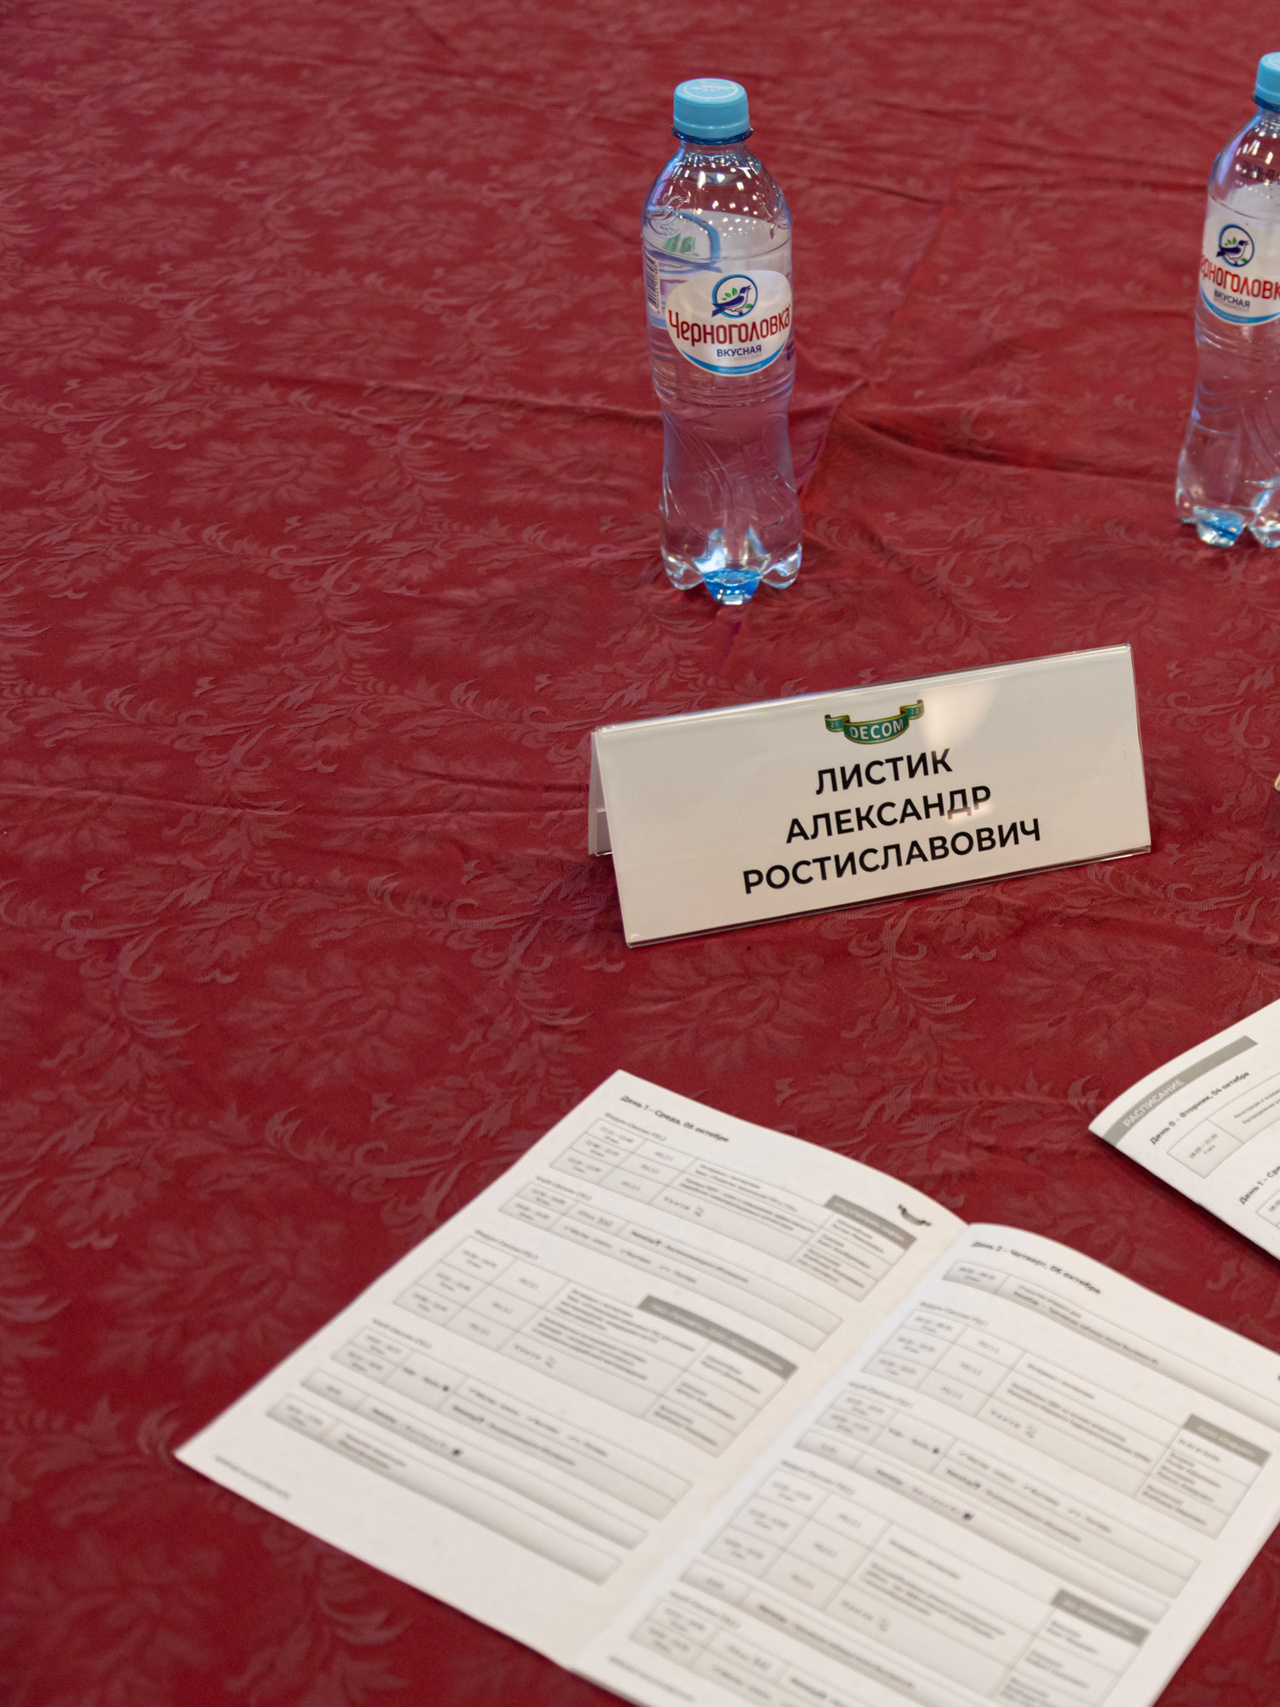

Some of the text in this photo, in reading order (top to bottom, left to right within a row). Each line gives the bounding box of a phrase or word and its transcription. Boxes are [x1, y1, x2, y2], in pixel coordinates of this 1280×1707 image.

[668, 307, 790, 346] Черноголовка
[716, 344, 762, 357] ВКУСНАЯ
[849, 718, 905, 740] DECOM
[816, 748, 953, 795] ЛИСТИК
[786, 785, 991, 844] АЛЕКСАНДР
[743, 819, 1041, 894] РОСТИСЛАВОВИЧ
[1123, 1080, 1184, 1127] РАСПИСАНИЕ
[1150, 1127, 1170, 1145] День
[1180, 1096, 1213, 1118] Вторник,
[1222, 1072, 1249, 1089] октября
[1239, 1187, 1259, 1205] День
